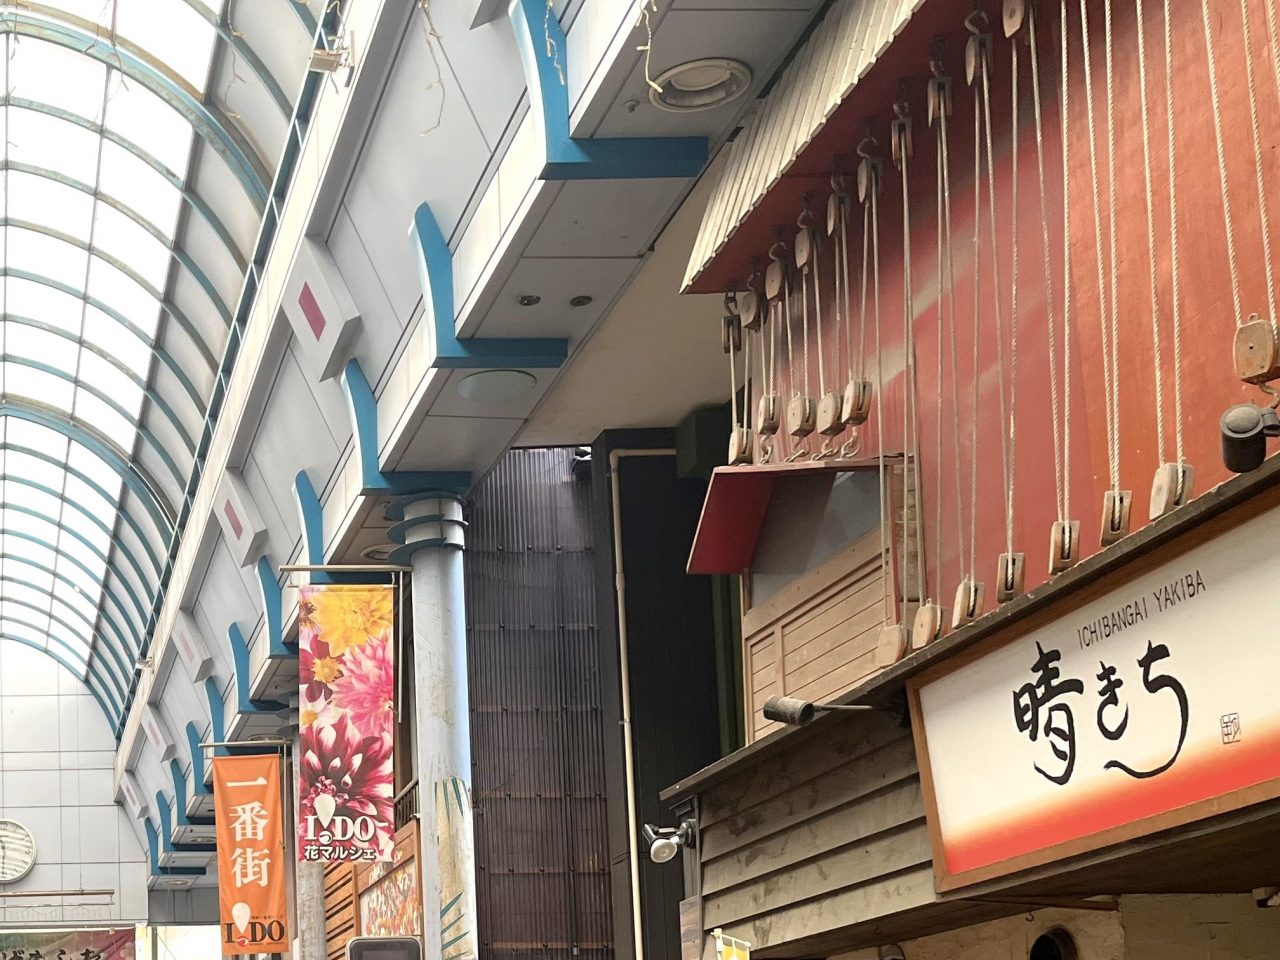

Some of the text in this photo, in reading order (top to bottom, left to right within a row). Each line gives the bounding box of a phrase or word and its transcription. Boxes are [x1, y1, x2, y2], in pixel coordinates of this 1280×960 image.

[1078, 570, 1206, 650] ICHIBANGAI YAKIBA
[1013, 640, 1189, 785] 晴きち
[224, 775, 270, 888] 一番街
[304, 845, 376, 861] 花マルシェ
